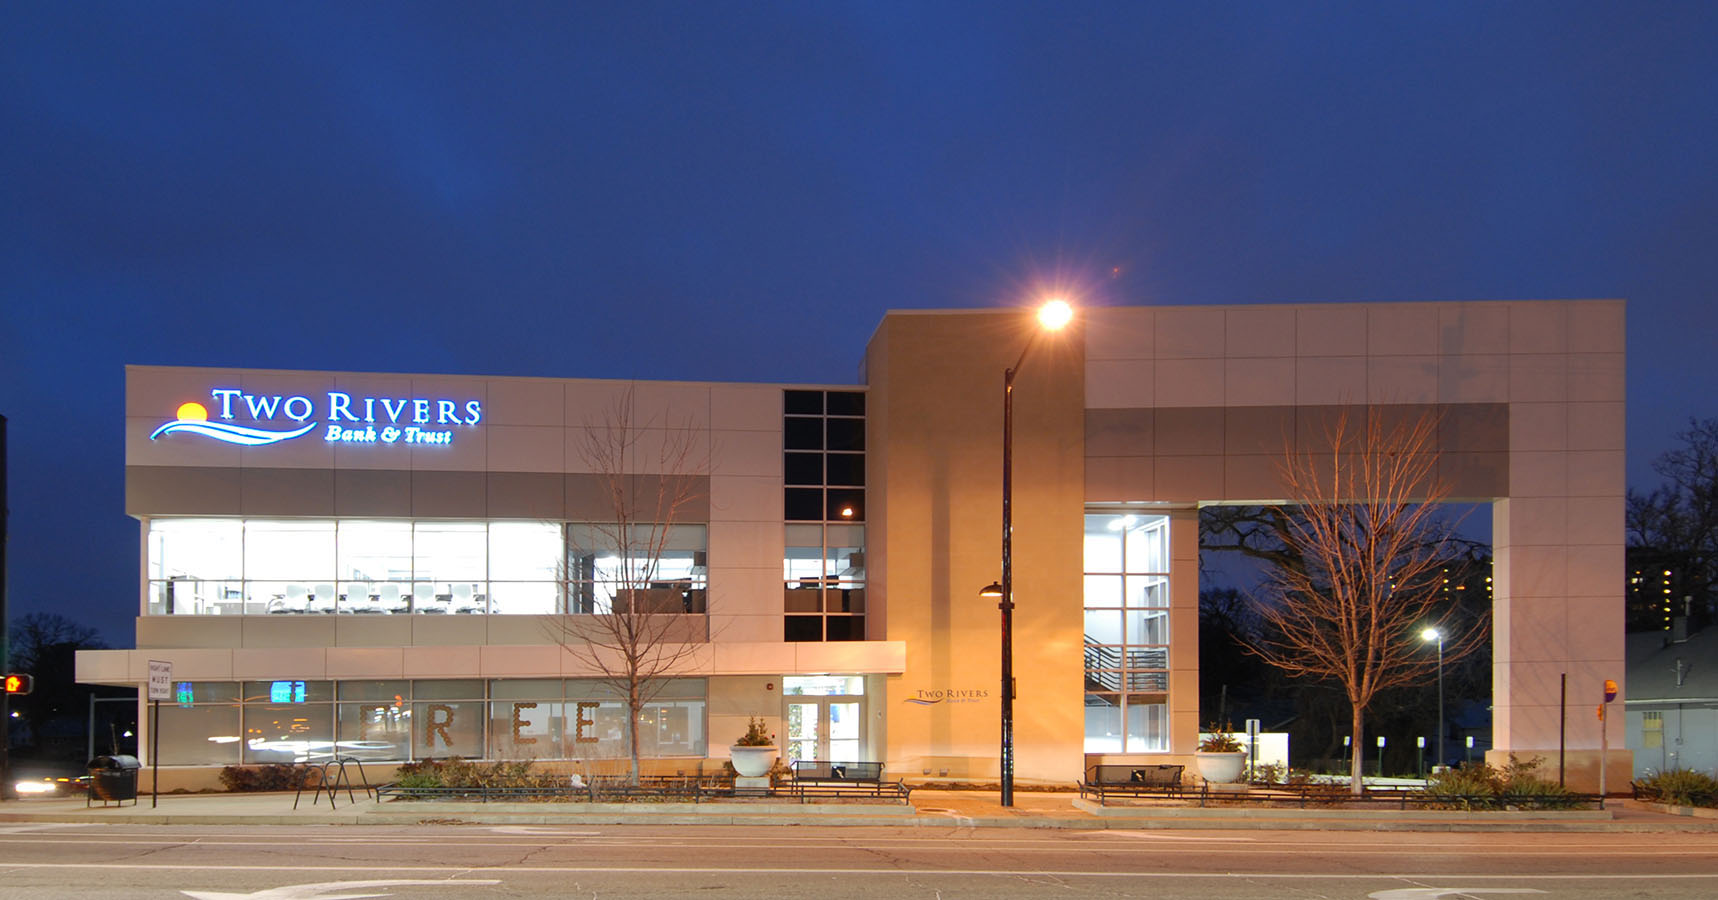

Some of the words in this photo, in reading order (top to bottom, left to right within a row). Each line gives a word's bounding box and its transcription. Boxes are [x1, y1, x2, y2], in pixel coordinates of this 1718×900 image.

[212, 389, 313, 421] TWO
[327, 392, 481, 425] RIVERS
[325, 425, 377, 442] Bank
[380, 427, 400, 443] &
[405, 427, 452, 444] Trust
[152, 676, 168, 684] MUST
[917, 689, 943, 698] TWO
[946, 689, 988, 697] RIVERS
